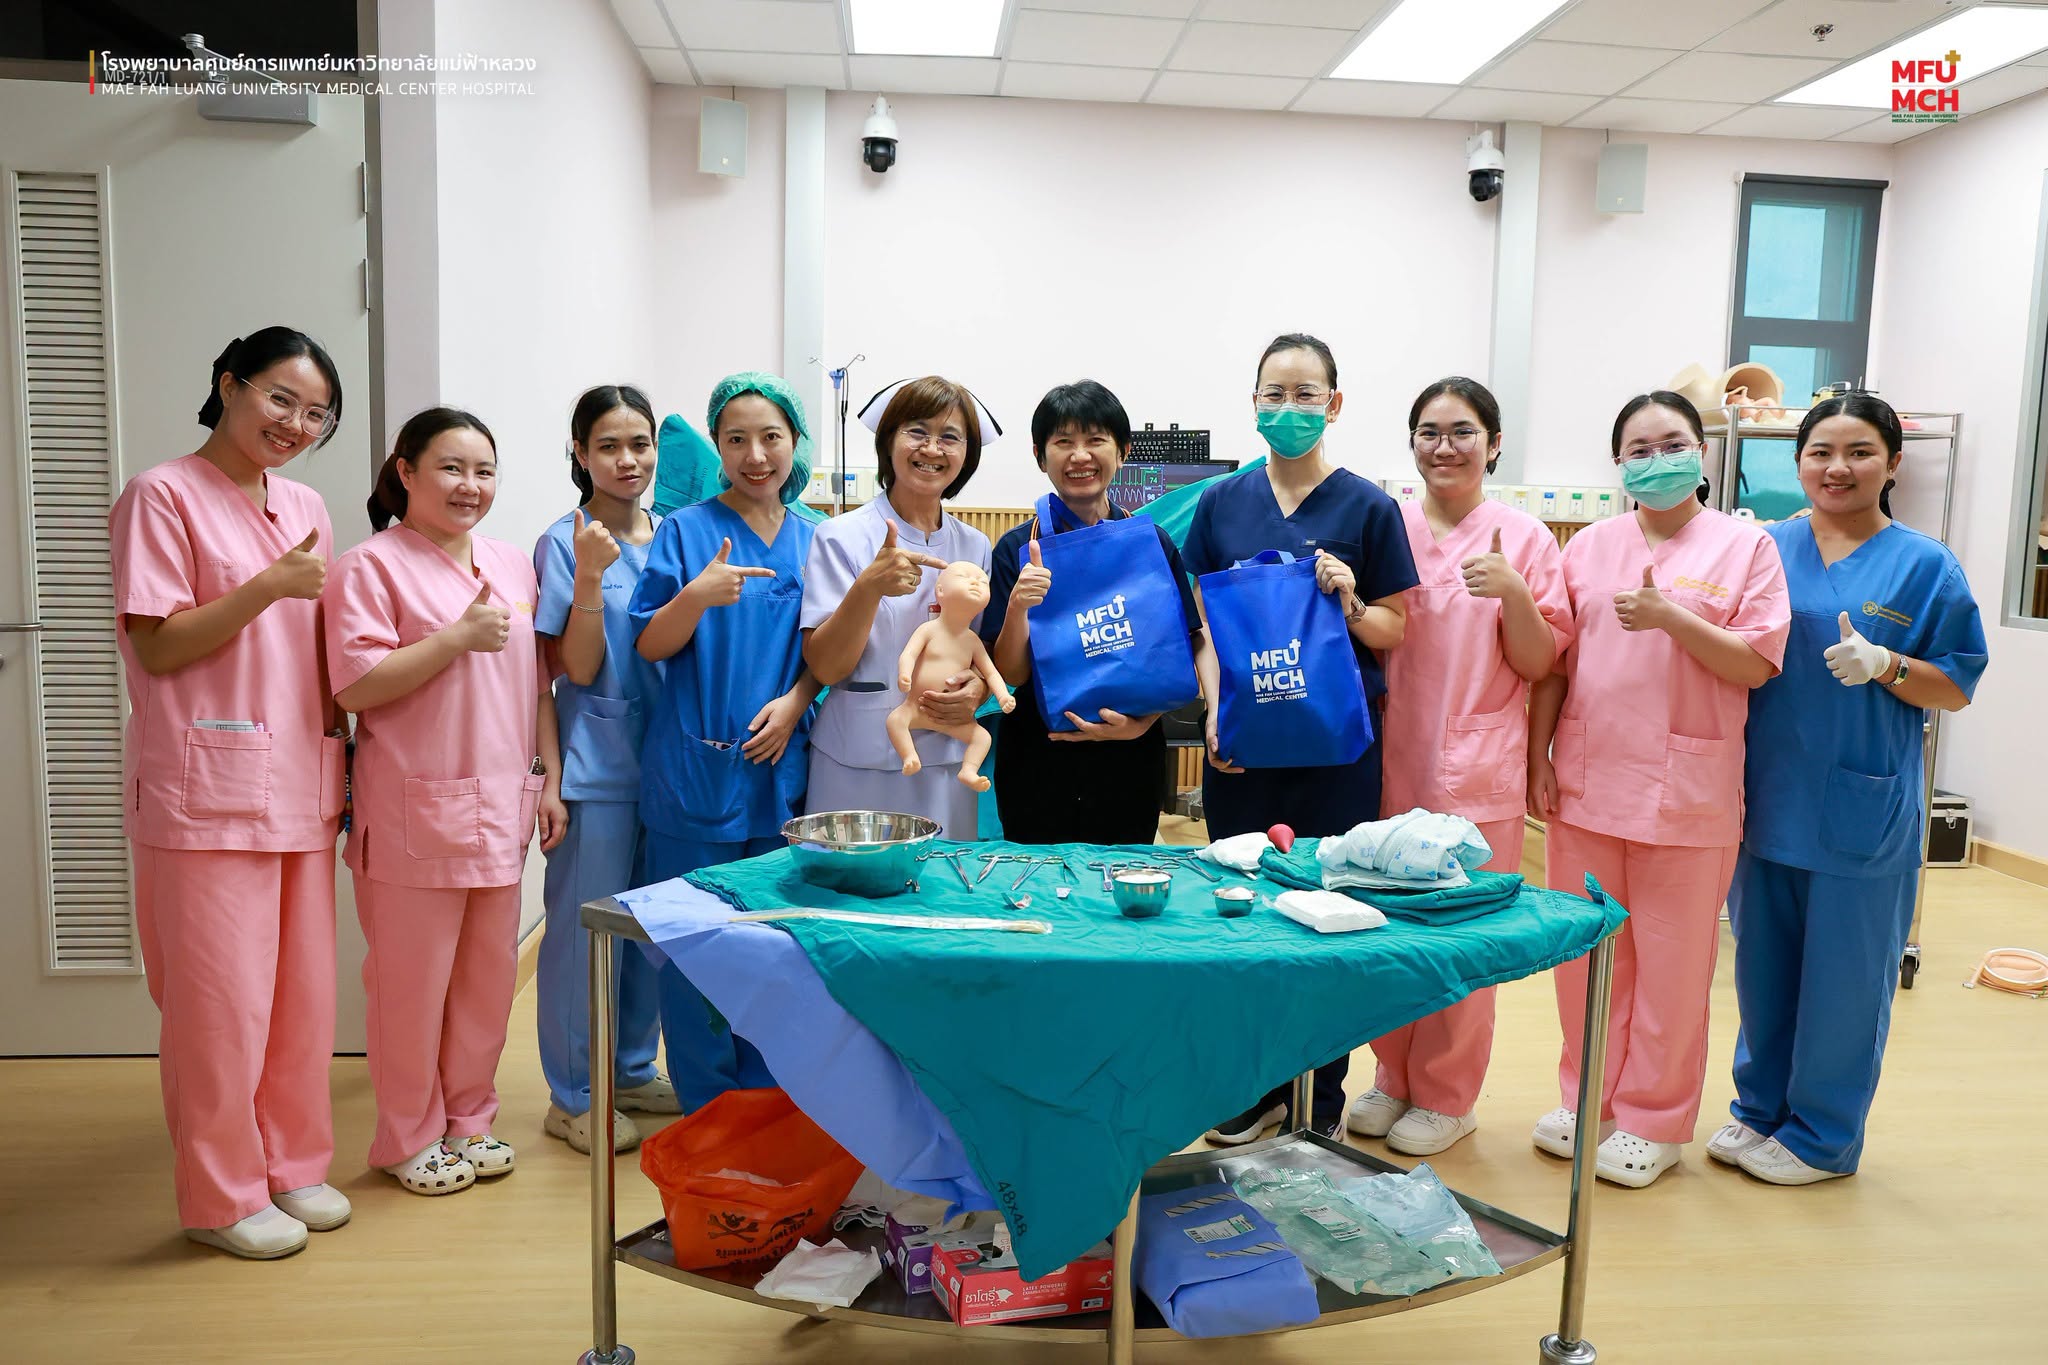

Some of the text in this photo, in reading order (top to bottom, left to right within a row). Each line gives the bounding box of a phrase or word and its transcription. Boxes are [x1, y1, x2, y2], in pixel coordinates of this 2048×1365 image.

[104, 70, 166, 84] MD-721/1
[1075, 594, 1126, 629] MFU
[1080, 620, 1133, 648] MCH
[1085, 641, 1135, 659] MEDICAL CENTER
[1250, 638, 1301, 670] MFU
[1253, 669, 1306, 693] MCH
[1256, 692, 1308, 704] MEDICAL CENTER
